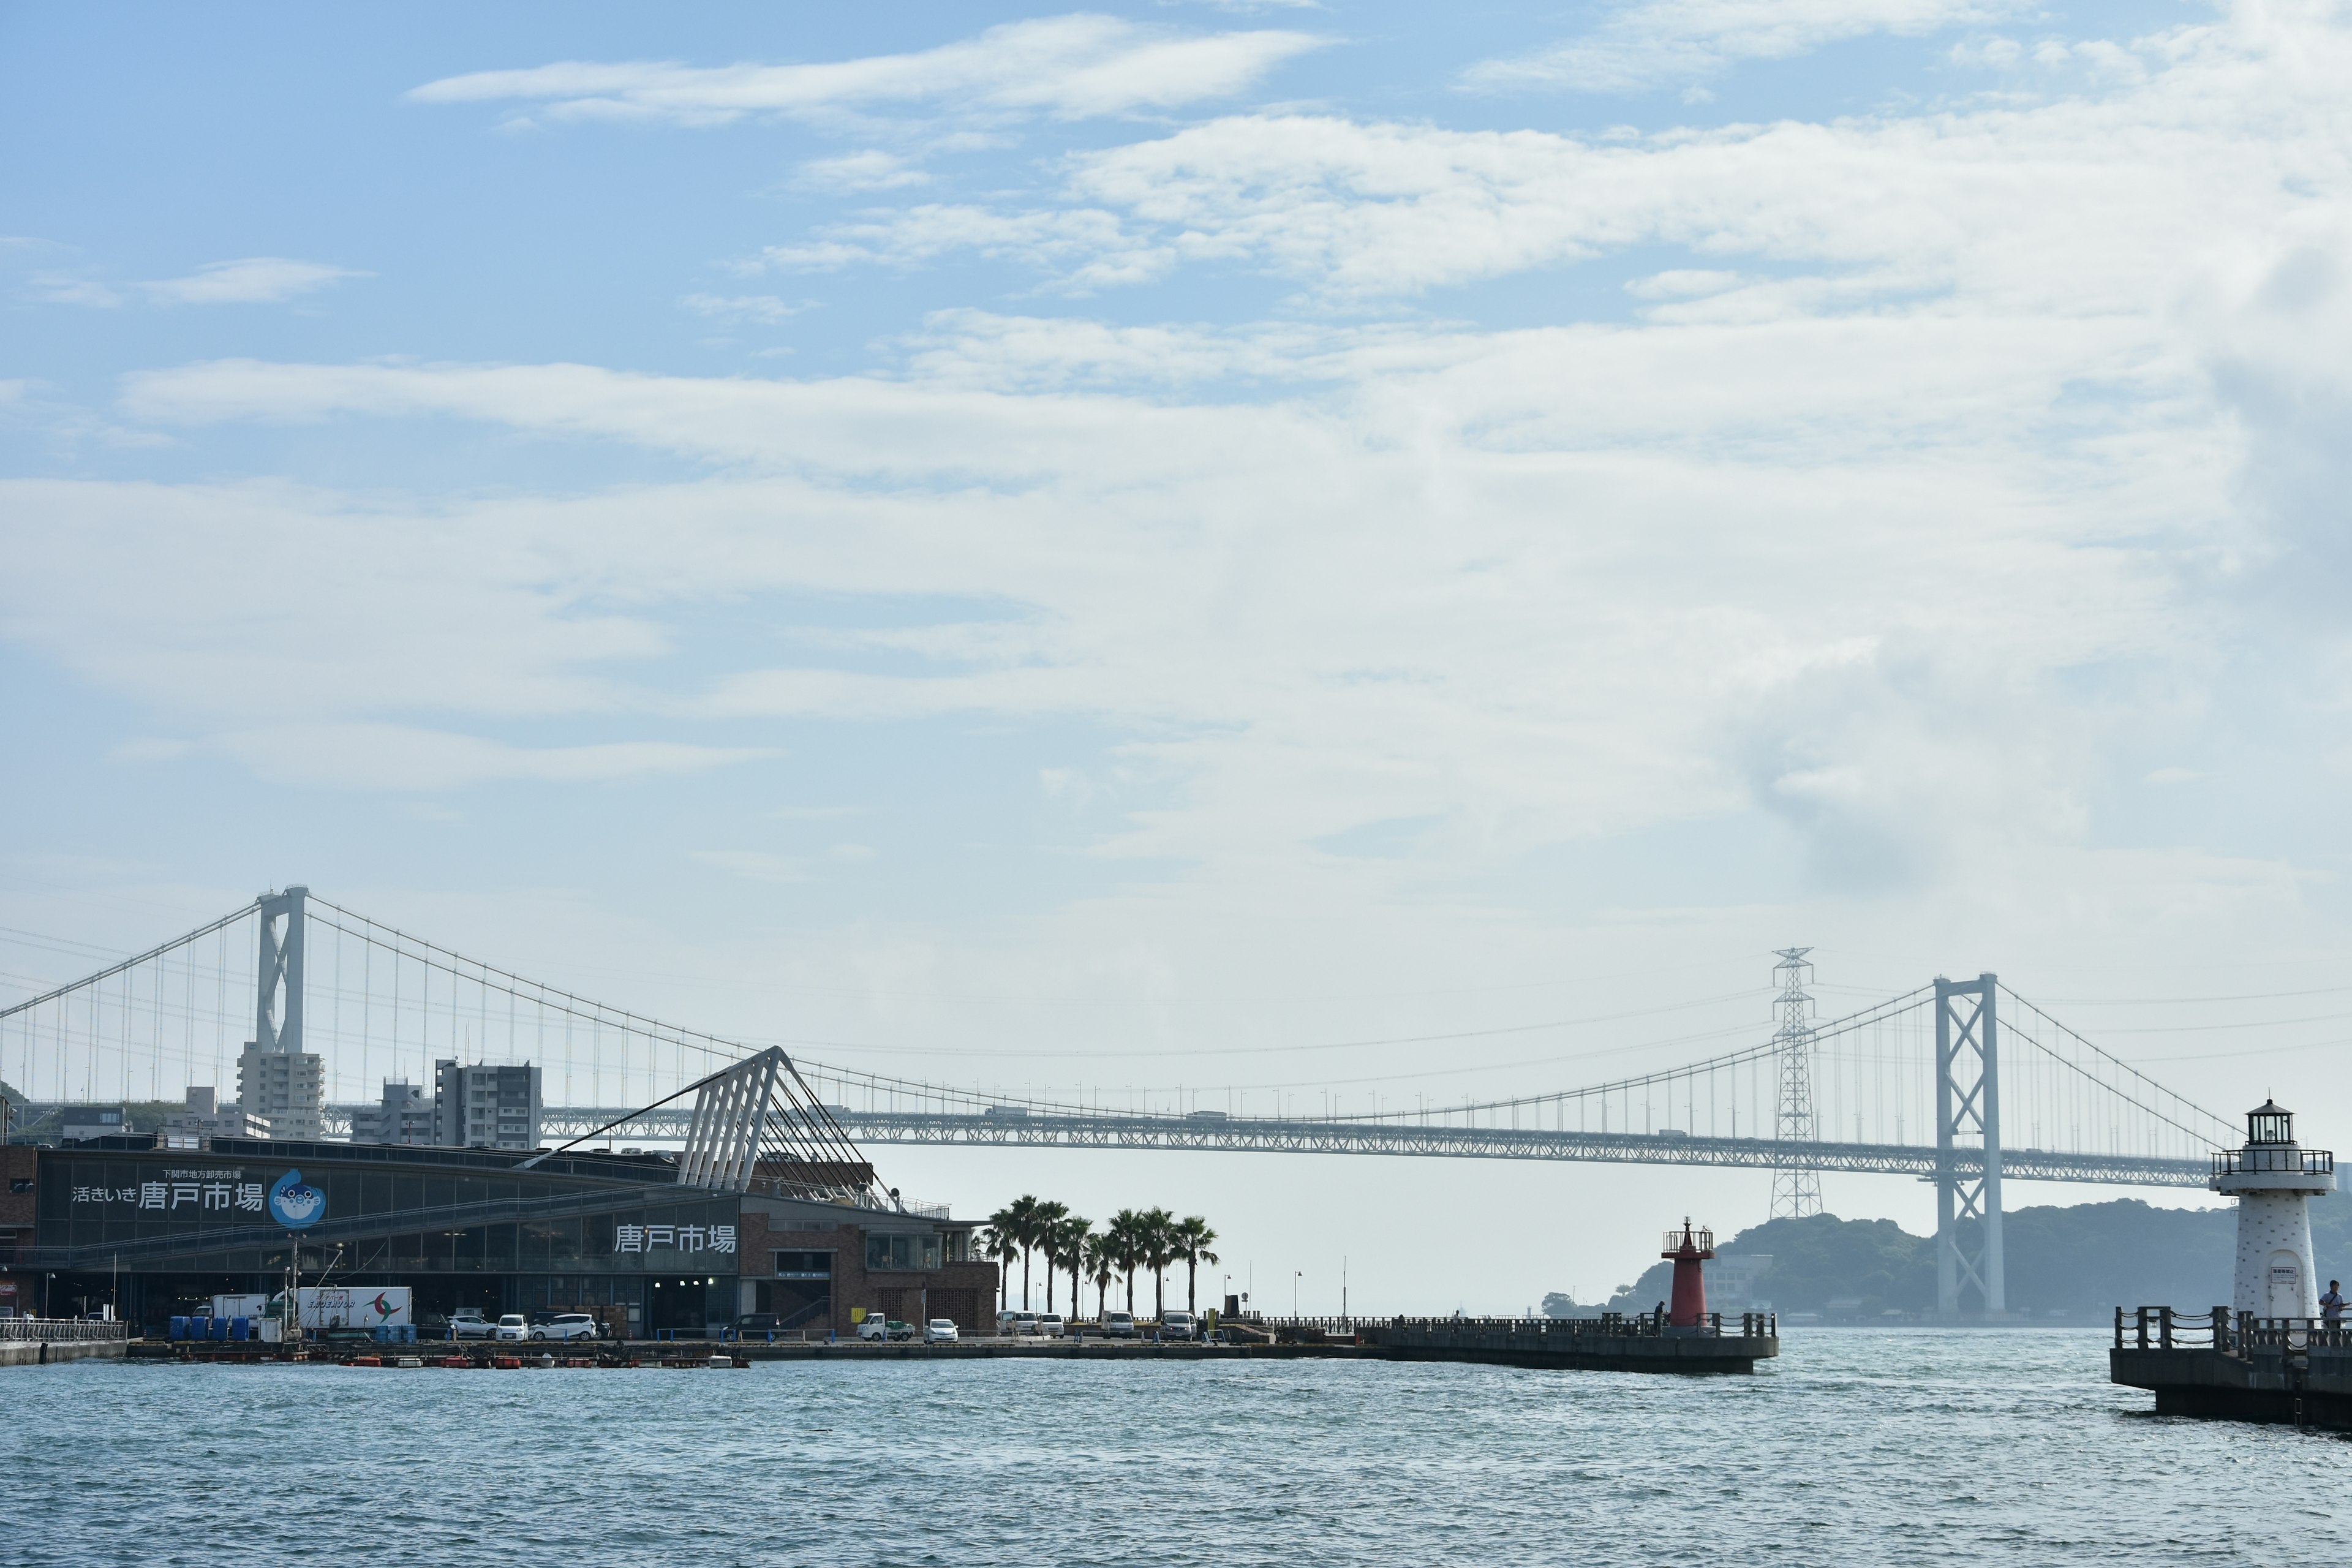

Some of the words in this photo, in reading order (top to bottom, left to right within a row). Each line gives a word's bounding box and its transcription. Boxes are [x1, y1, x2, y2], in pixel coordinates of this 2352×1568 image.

[162, 1169, 241, 1180] 下関市地方卸売市場
[614, 1224, 736, 1253] 唐戸市場
